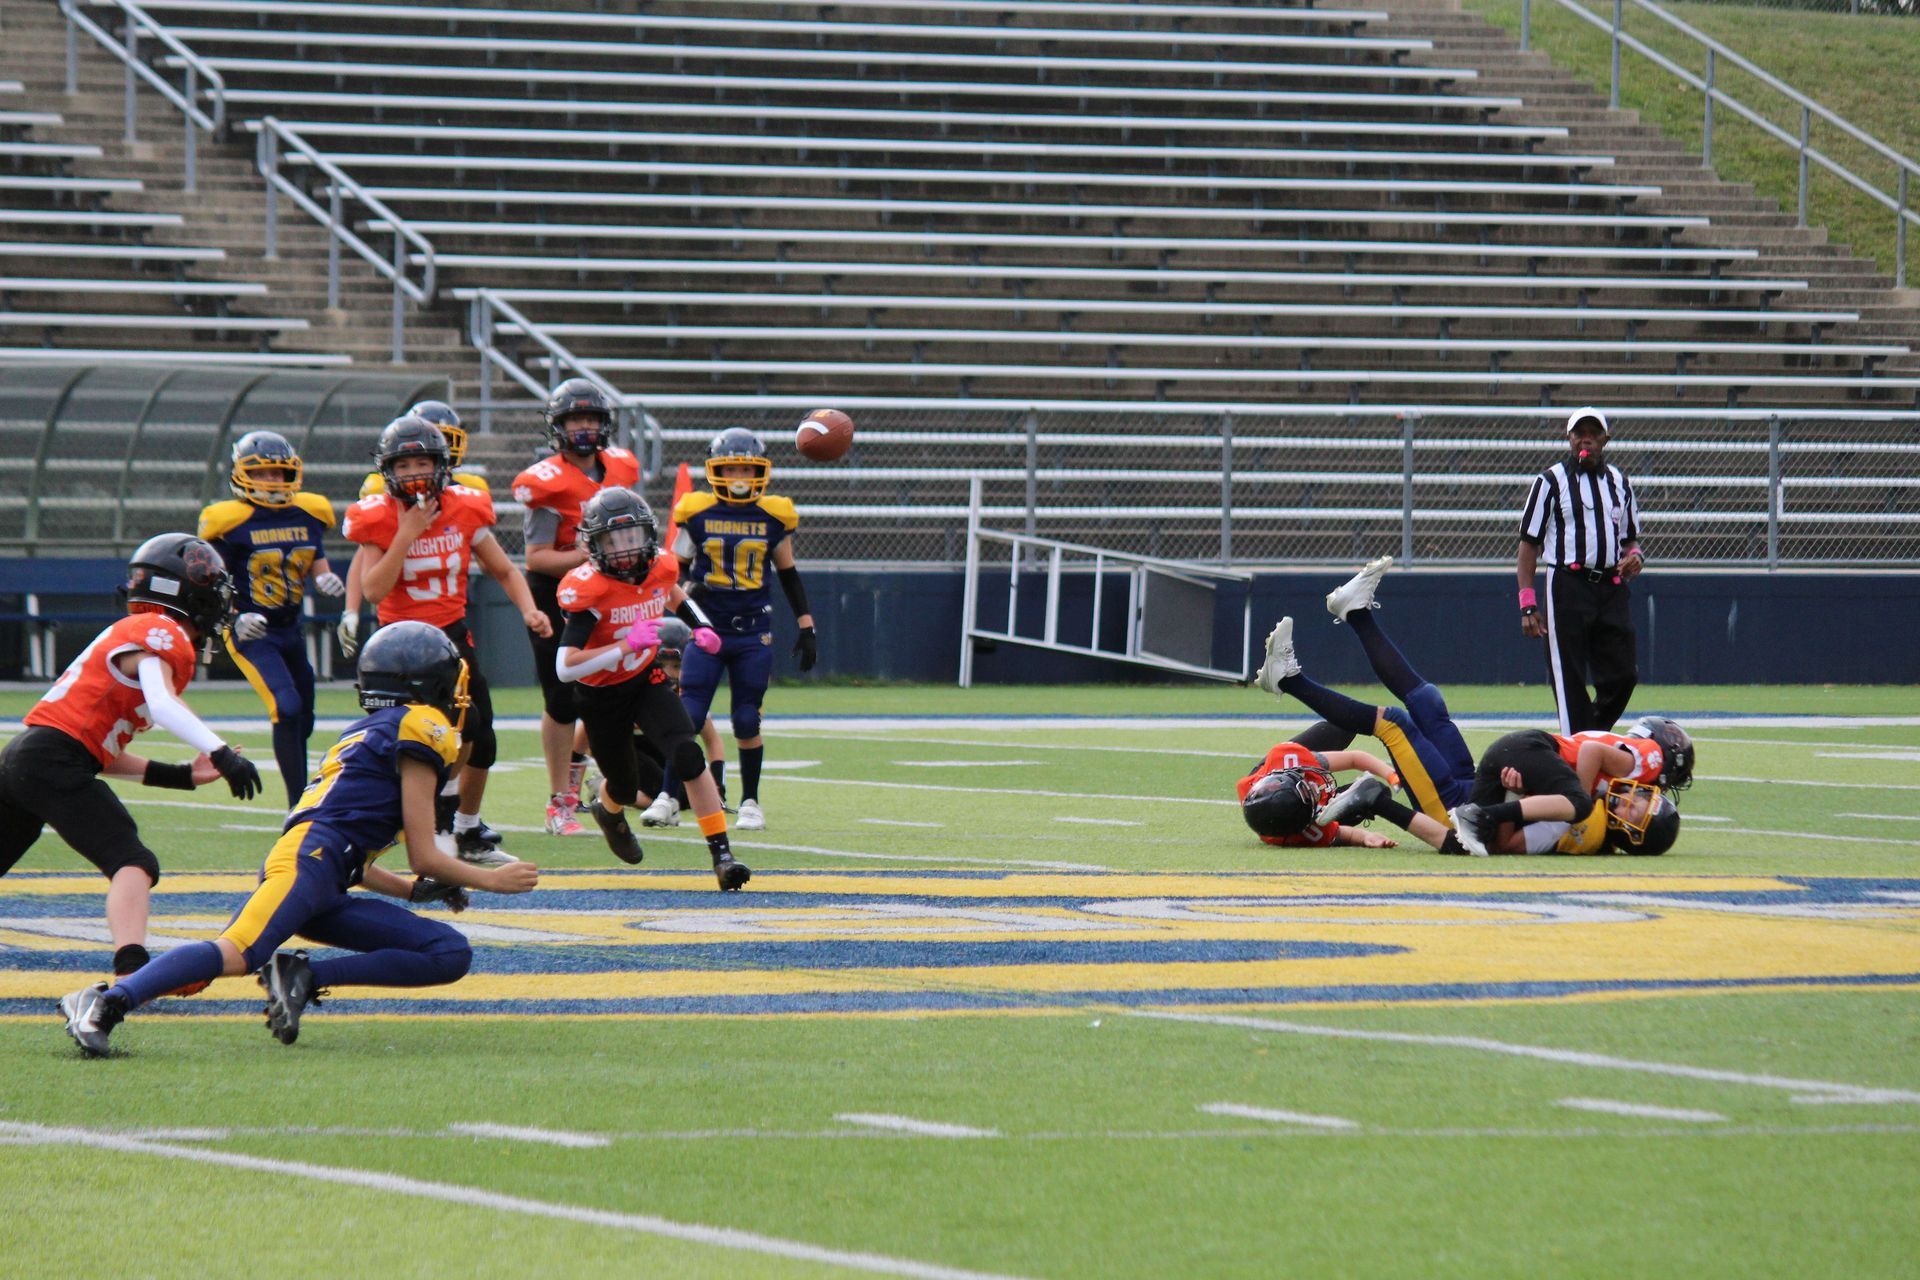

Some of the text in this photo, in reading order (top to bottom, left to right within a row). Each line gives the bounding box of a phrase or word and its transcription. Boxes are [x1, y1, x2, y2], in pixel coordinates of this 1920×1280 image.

[250, 526, 309, 545] HORNETS
[704, 519, 767, 536] HORNETS
[407, 532, 464, 557] RIGHTON
[403, 552, 462, 601] 51
[702, 537, 769, 591] 10
